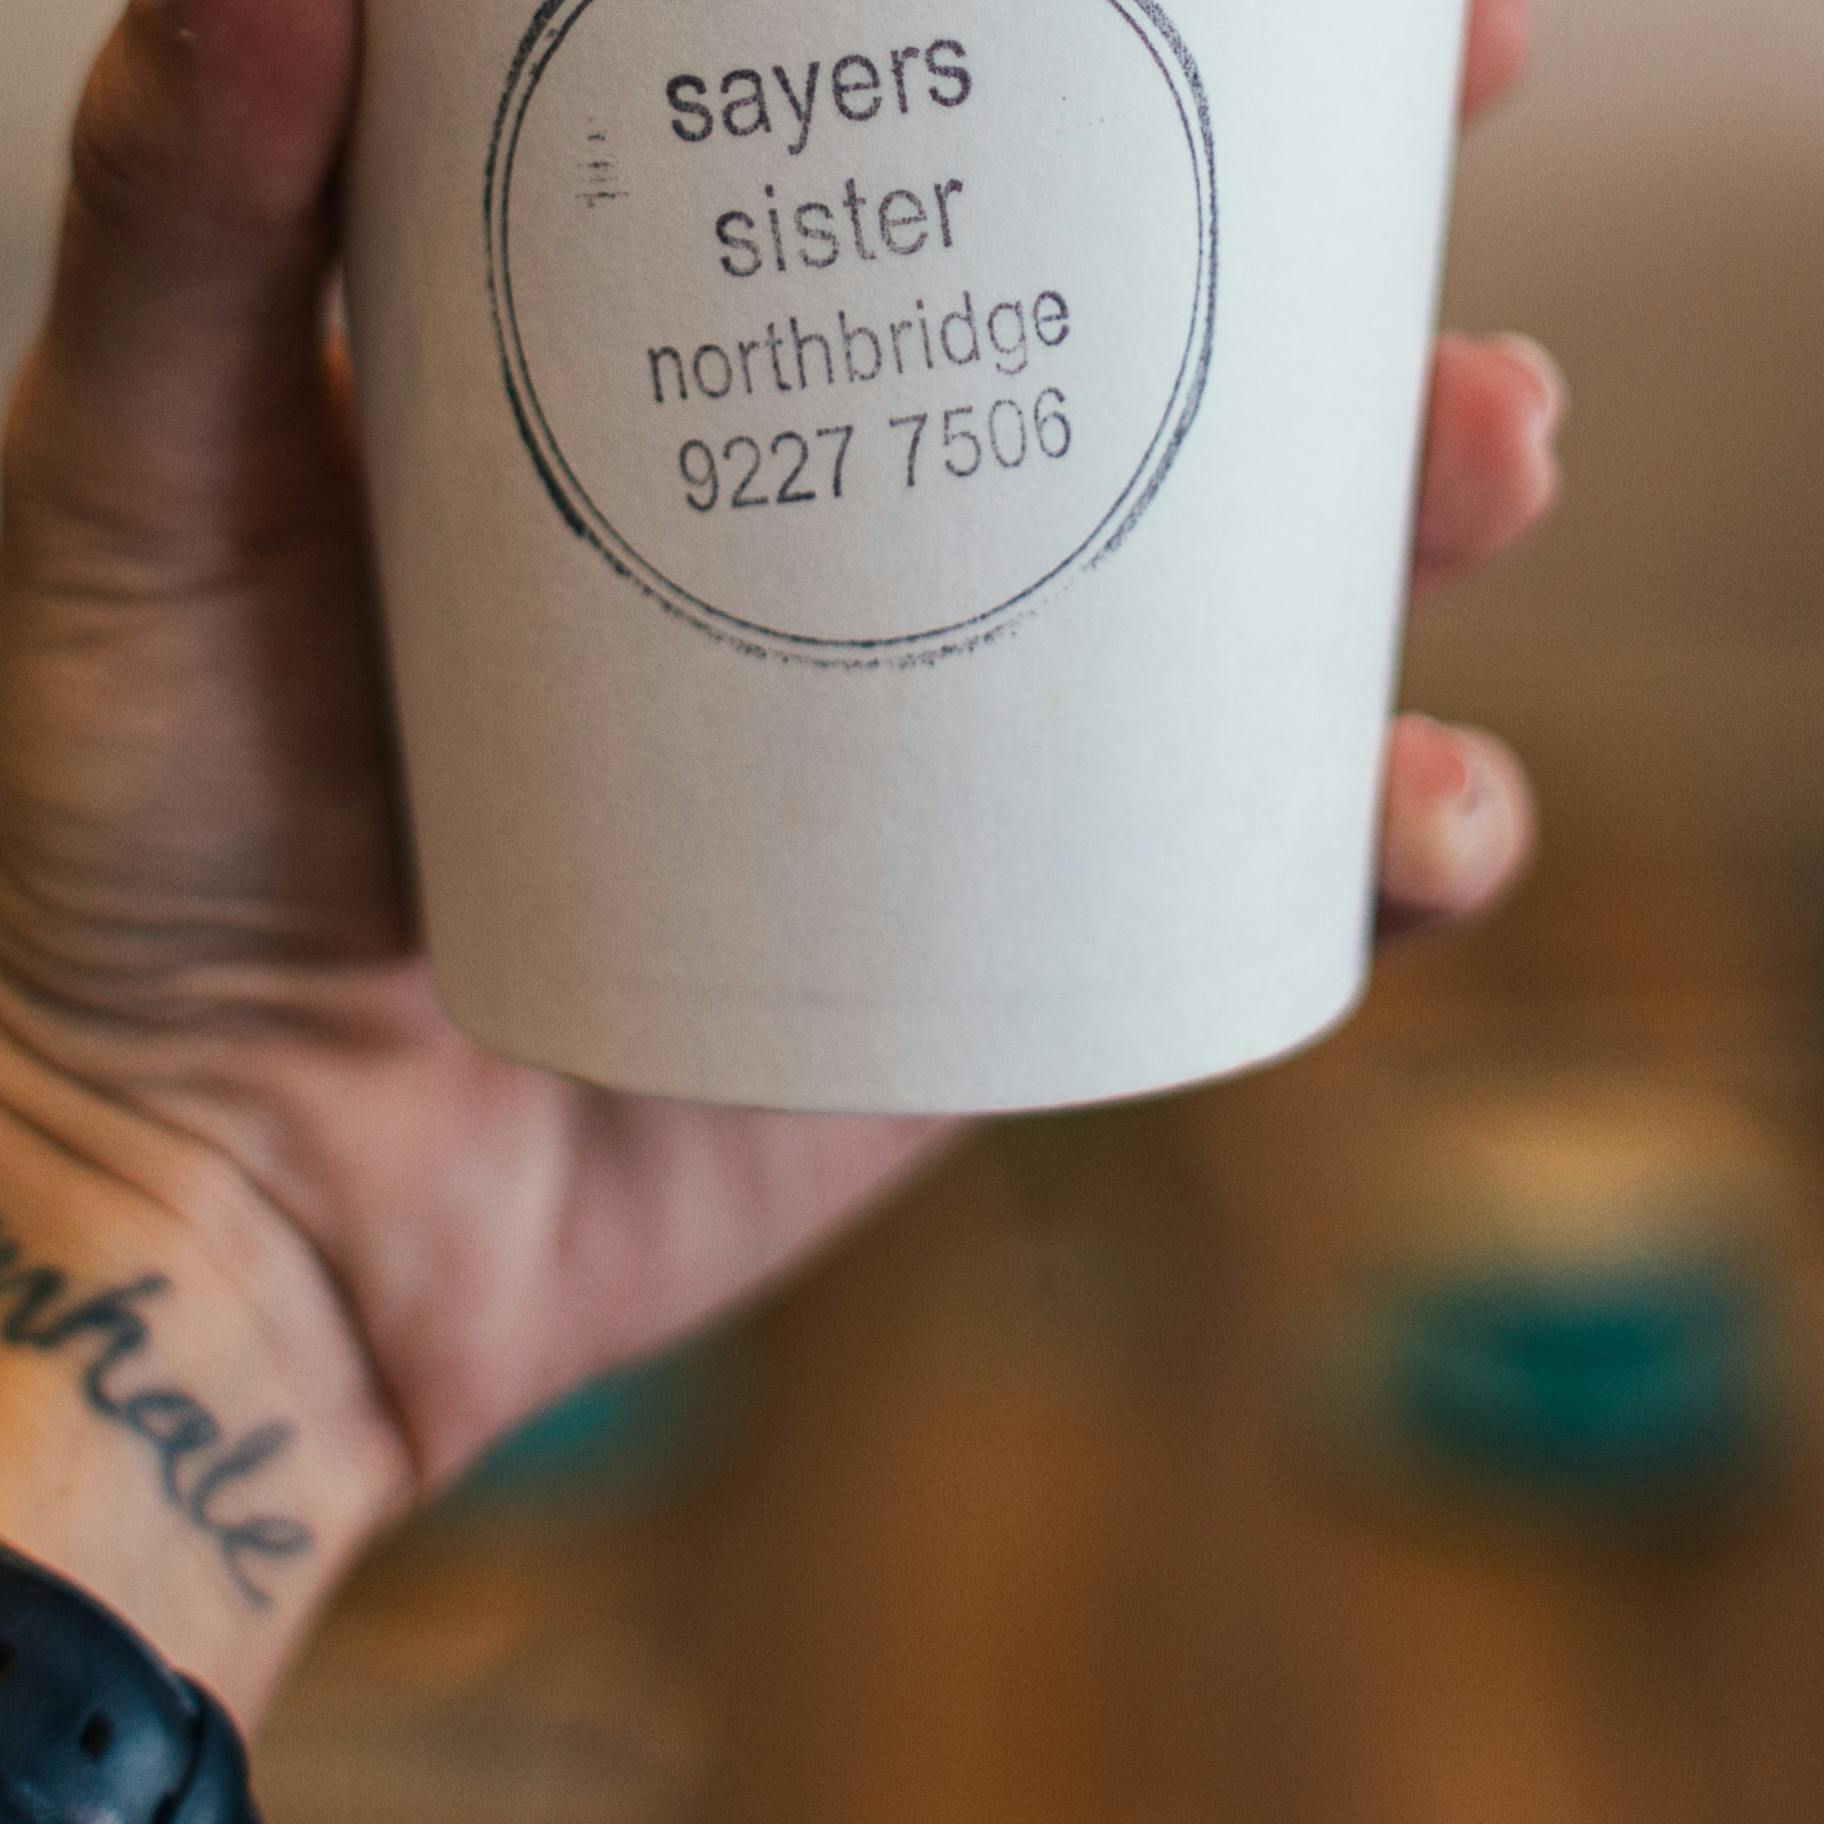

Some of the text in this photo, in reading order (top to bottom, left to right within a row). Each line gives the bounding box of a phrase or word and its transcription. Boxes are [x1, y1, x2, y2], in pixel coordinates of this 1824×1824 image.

[665, 37, 973, 155] sayers
[715, 177, 964, 278] sister
[647, 289, 1071, 404] northbridge
[678, 387, 1072, 513] 9227 7506
